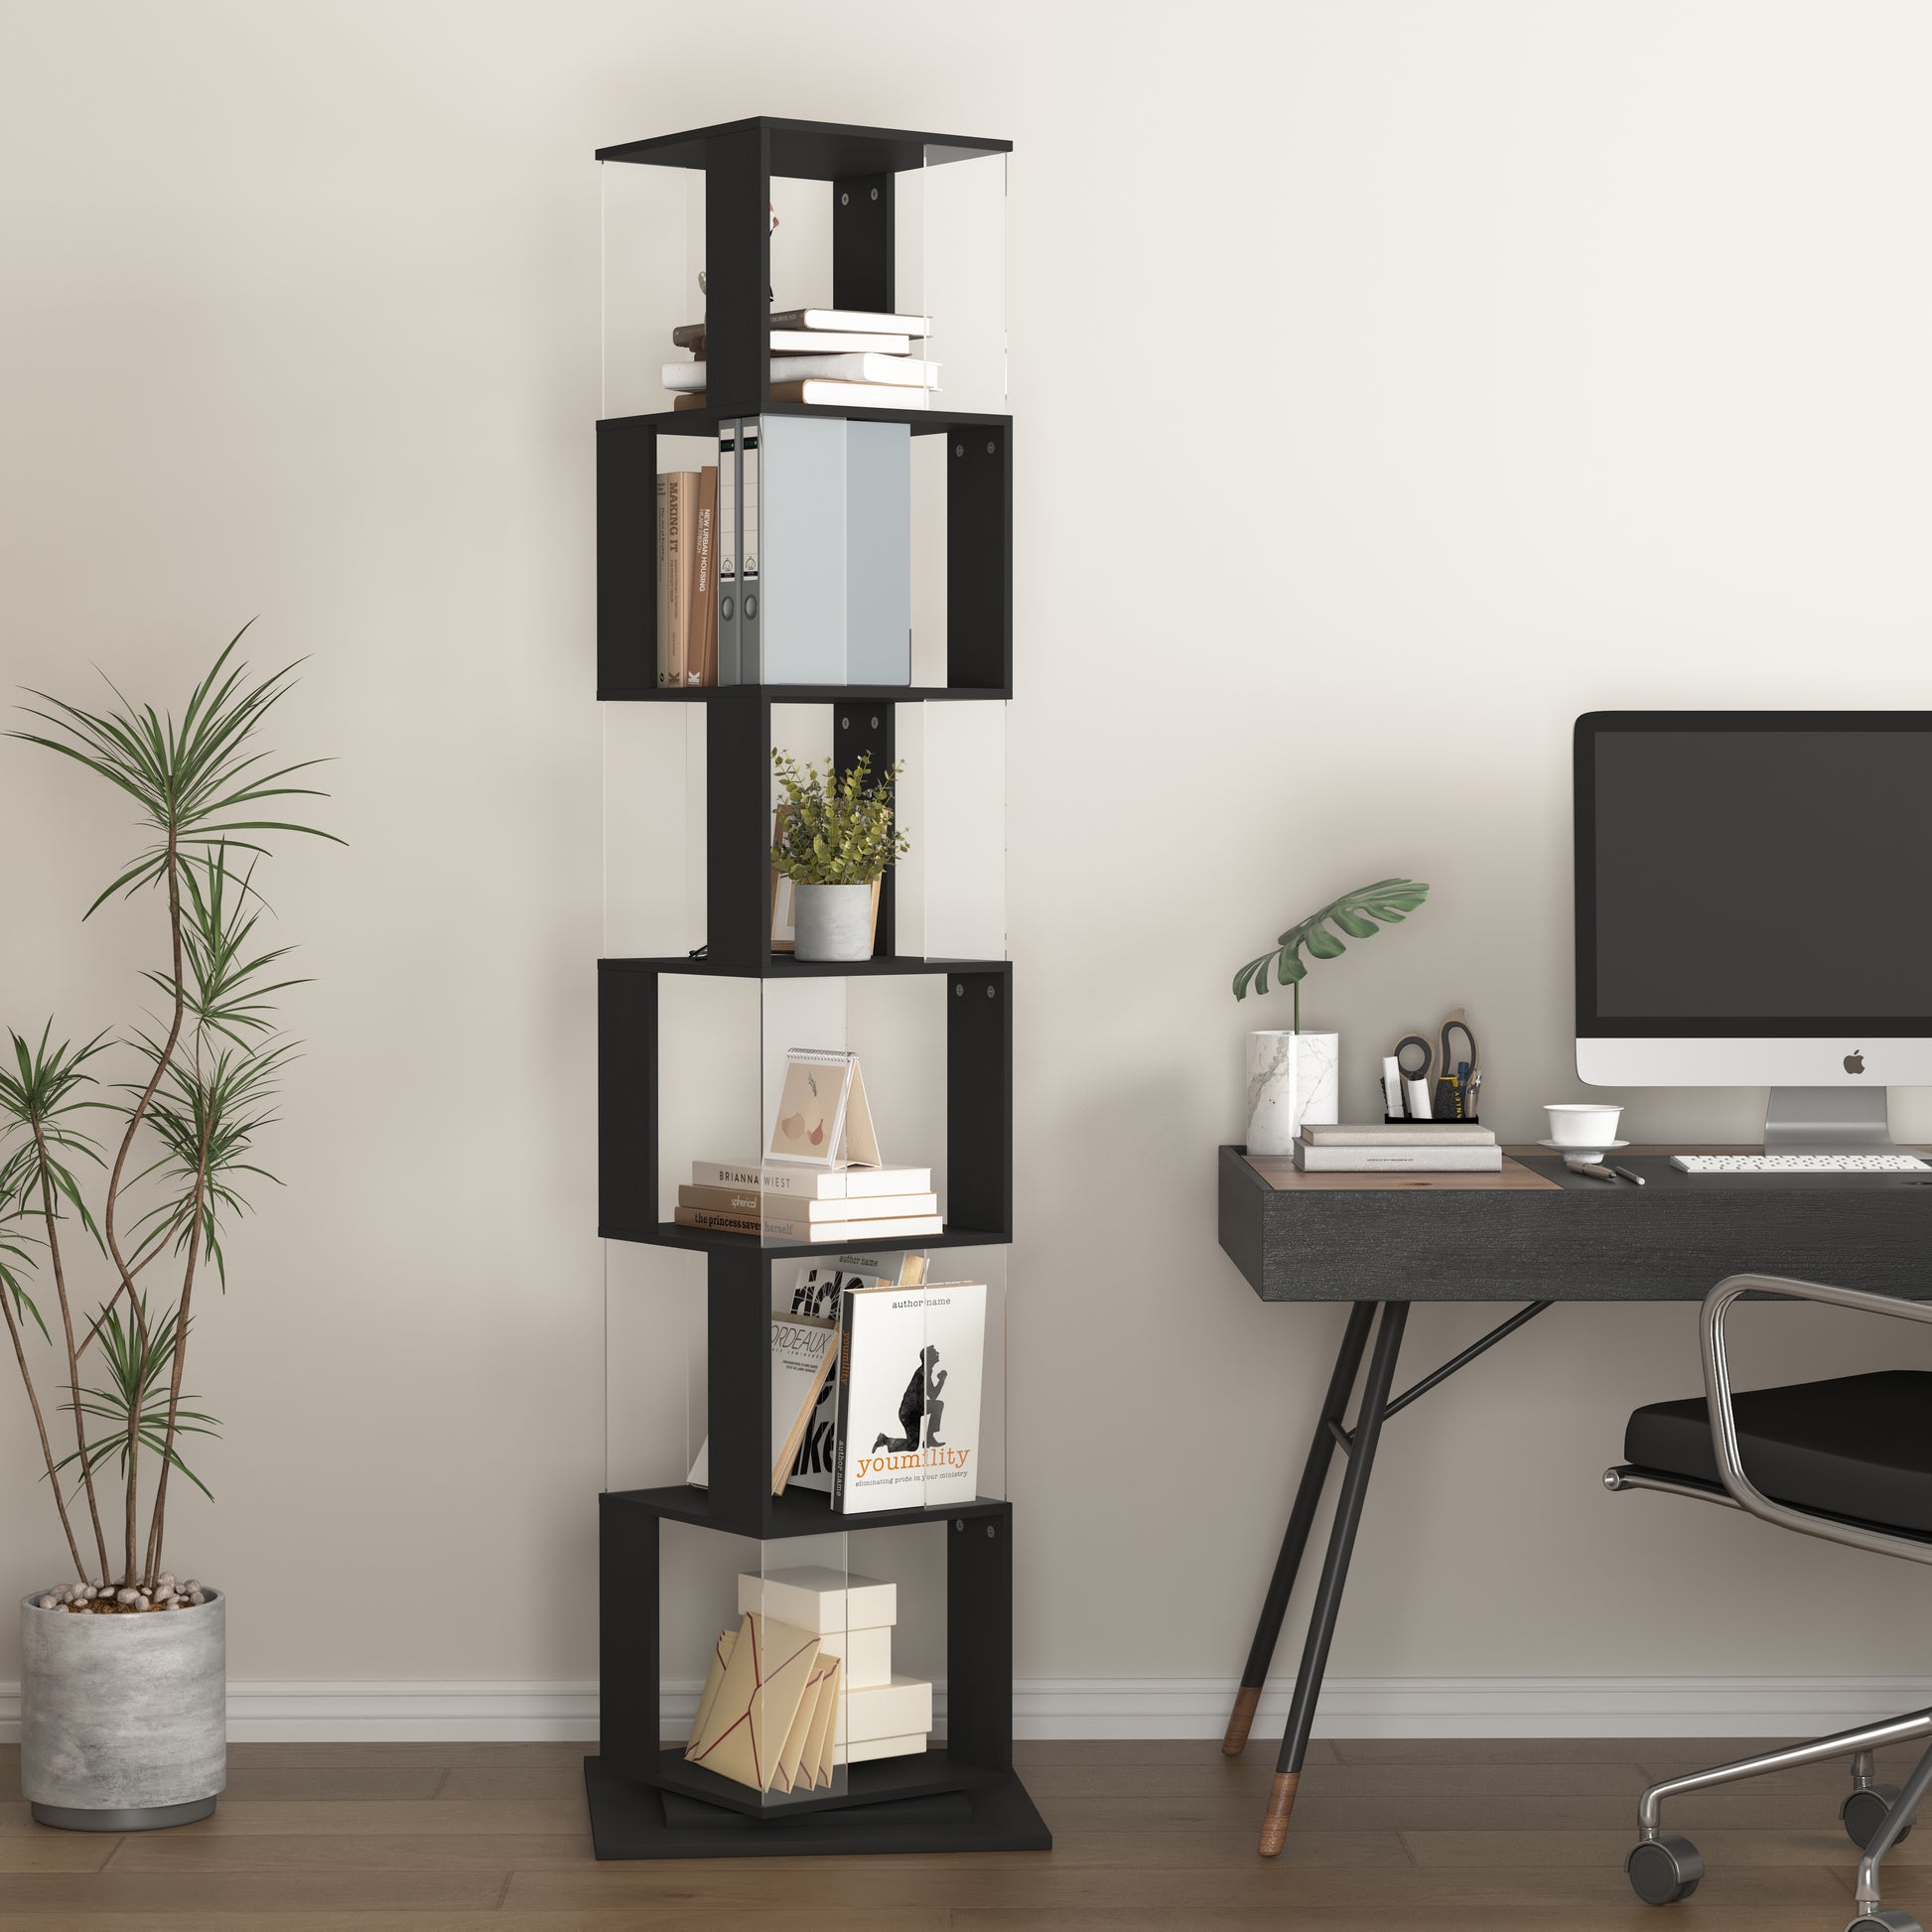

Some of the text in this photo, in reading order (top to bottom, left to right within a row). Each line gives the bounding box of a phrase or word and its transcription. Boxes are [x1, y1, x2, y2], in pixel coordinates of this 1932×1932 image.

[669, 482, 679, 553] MAKING IT
[719, 1171, 790, 1188] BRIANNA WIEST
[695, 1212, 708, 1224] the
[708, 1215, 742, 1229] princess
[764, 1221, 793, 1235] herself
[839, 1255, 879, 1267] author name
[892, 1298, 951, 1309] author name
[857, 1447, 971, 1478] youmility
[855, 1477, 894, 1487] eliminating
[895, 1475, 912, 1484] pride
[921, 1473, 939, 1482] your
